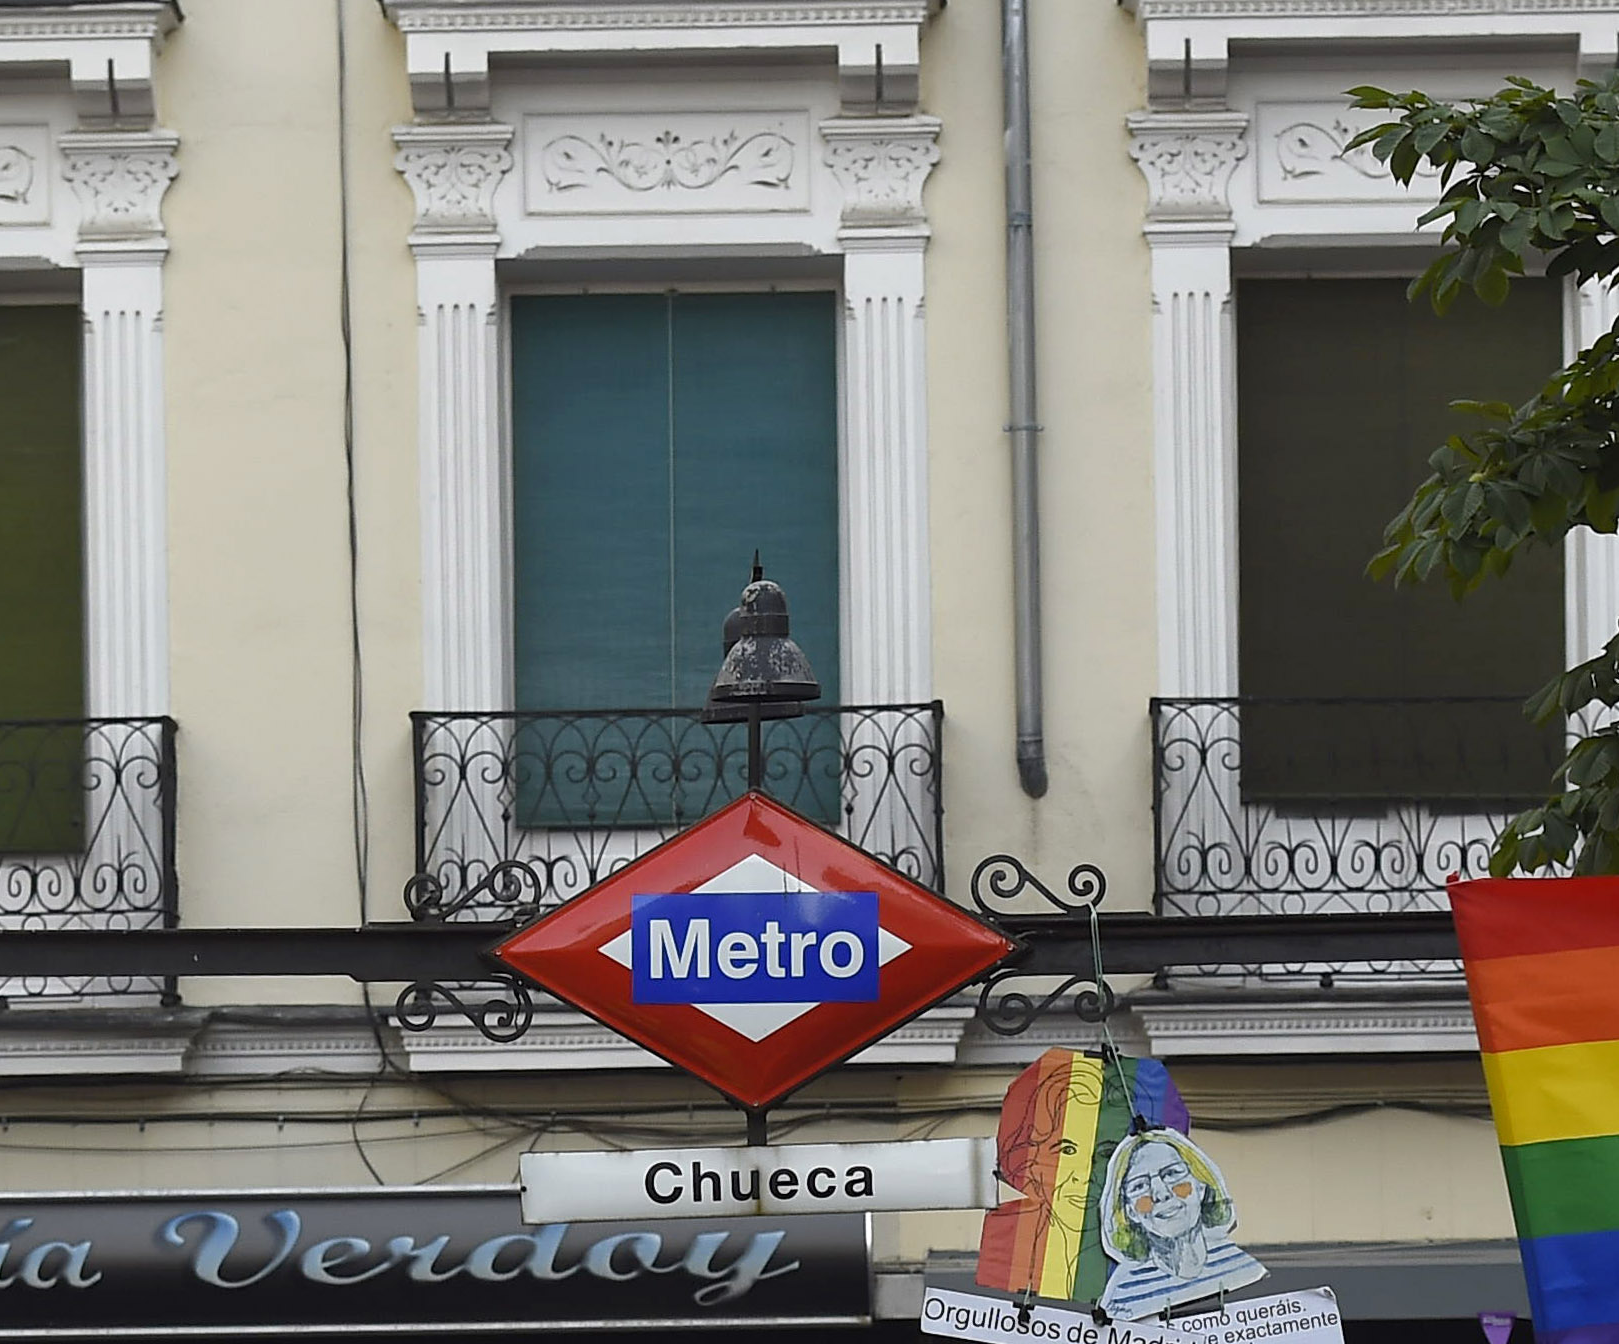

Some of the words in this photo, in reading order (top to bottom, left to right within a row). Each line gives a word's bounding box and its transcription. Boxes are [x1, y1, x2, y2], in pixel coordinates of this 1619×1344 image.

[647, 917, 865, 981] Metro
[643, 1160, 876, 1205] Chueca
[162, 1209, 801, 1306] Verdoy
[924, 1296, 1062, 1342] Orgullosos
[1181, 1312, 1231, 1334] como
[1235, 1299, 1308, 1331] queráis.
[1224, 1311, 1339, 1344] exactamente
